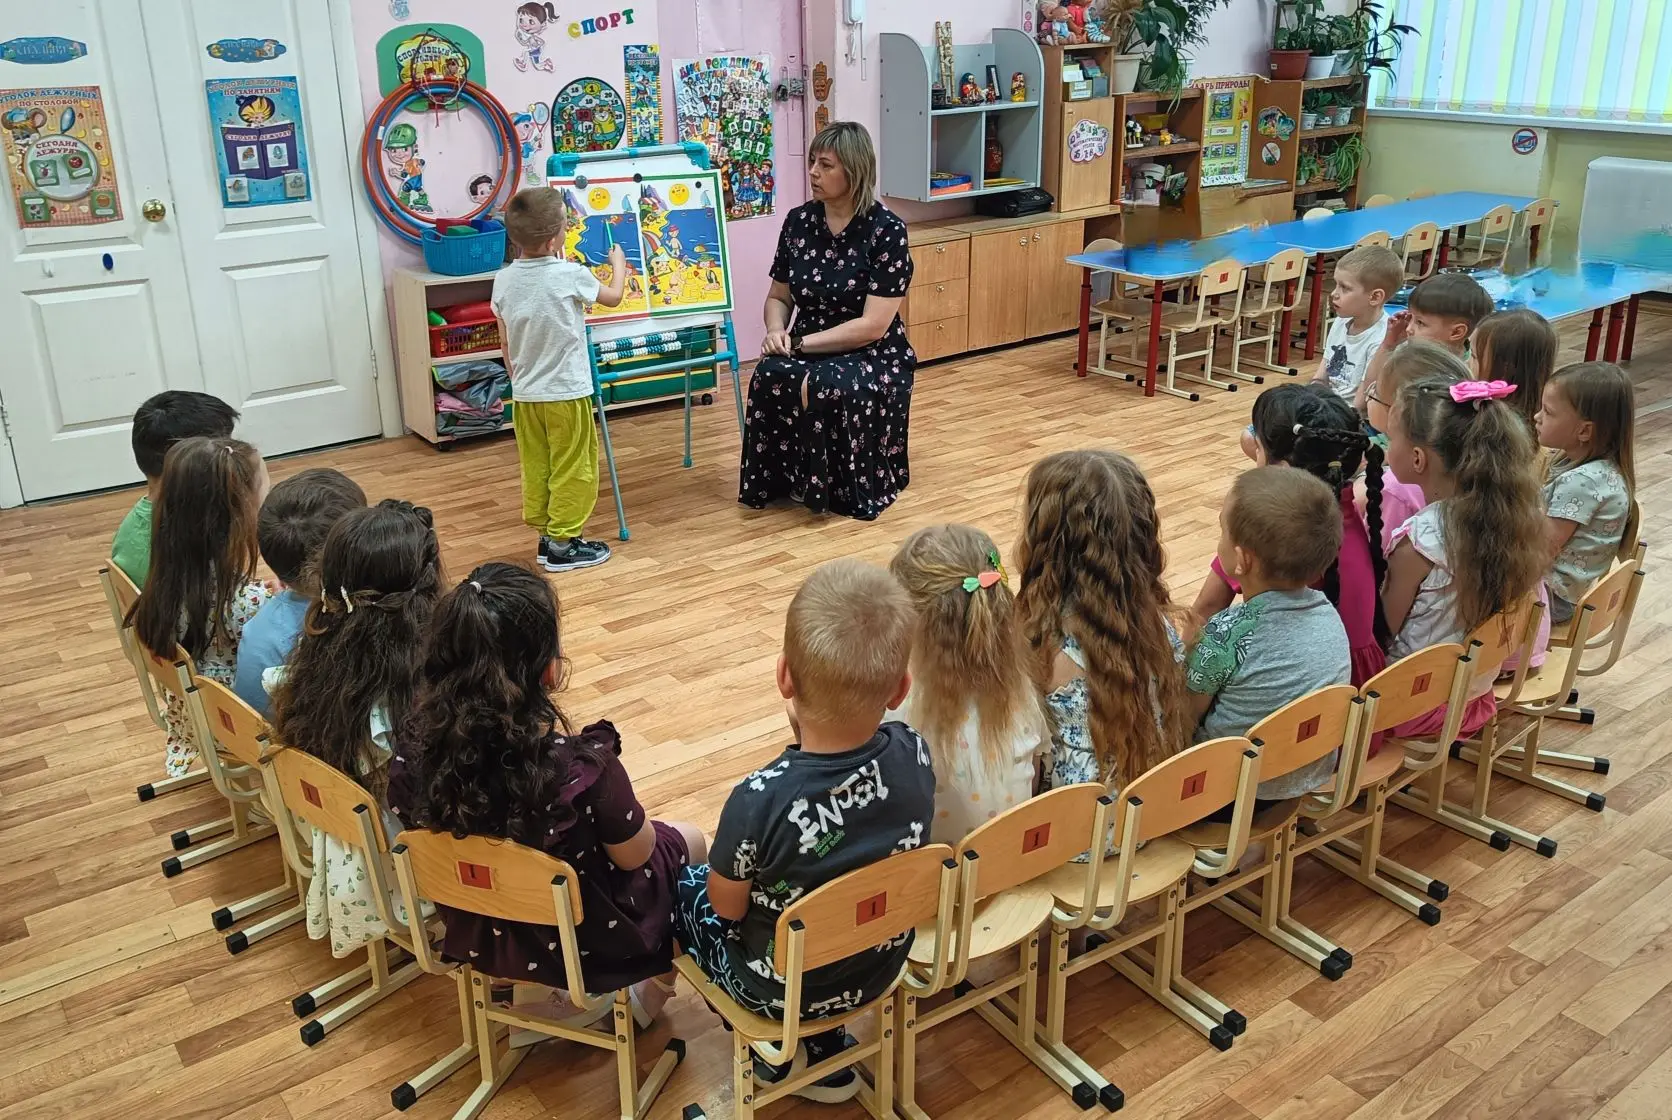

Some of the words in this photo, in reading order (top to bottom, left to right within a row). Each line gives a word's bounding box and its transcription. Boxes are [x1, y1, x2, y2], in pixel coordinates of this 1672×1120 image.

[567, 8, 634, 38] СПОРТ
[705, 57, 763, 72] РОЖДЕНИЯ
[1215, 80, 1250, 90] ПРИРОДЫ
[40, 89, 97, 99] ДЕЖУРНЫХ
[35, 140, 78, 149] СЕГОДНЯ
